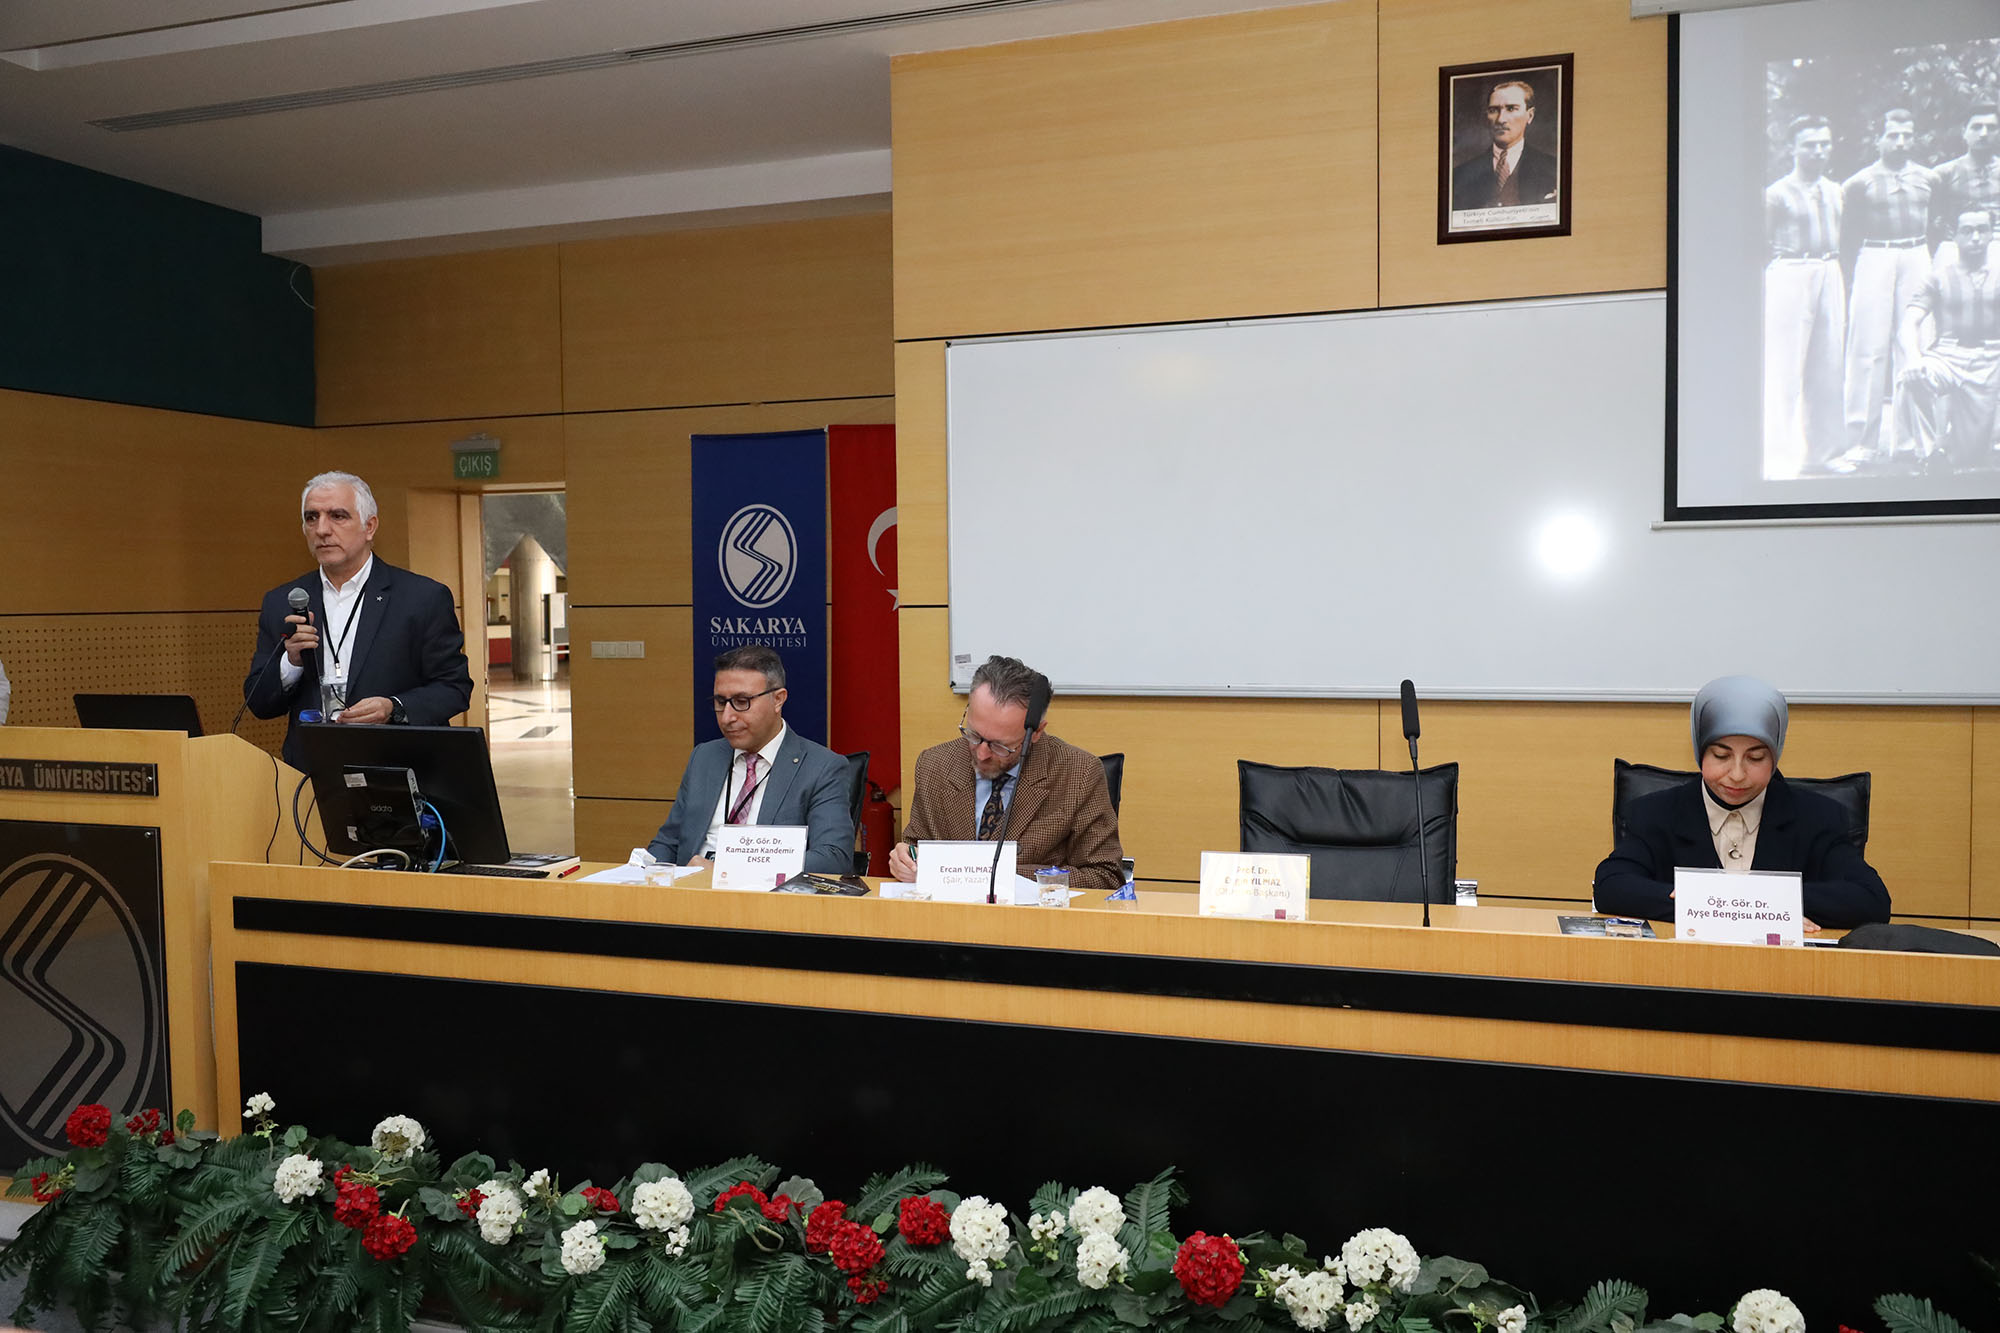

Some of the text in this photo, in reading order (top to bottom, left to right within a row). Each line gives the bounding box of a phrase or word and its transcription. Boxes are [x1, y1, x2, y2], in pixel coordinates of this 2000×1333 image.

[459, 455, 492, 477] ÇIKIŞ
[710, 616, 807, 634] SAKARYA
[711, 635, 807, 648] ÜNİVERSİTESİ
[33, 763, 147, 792] ÜNİVERSİTESİ
[739, 836, 783, 846] Öğr. Gör. Dr.
[725, 846, 795, 855] Ramazan Kandemir
[964, 866, 993, 874] YILMAZ
[1707, 896, 1770, 909] Öğr. Gör. Dr.
[1687, 908, 1791, 921] Ayşe Bengisu AKDAĞ
